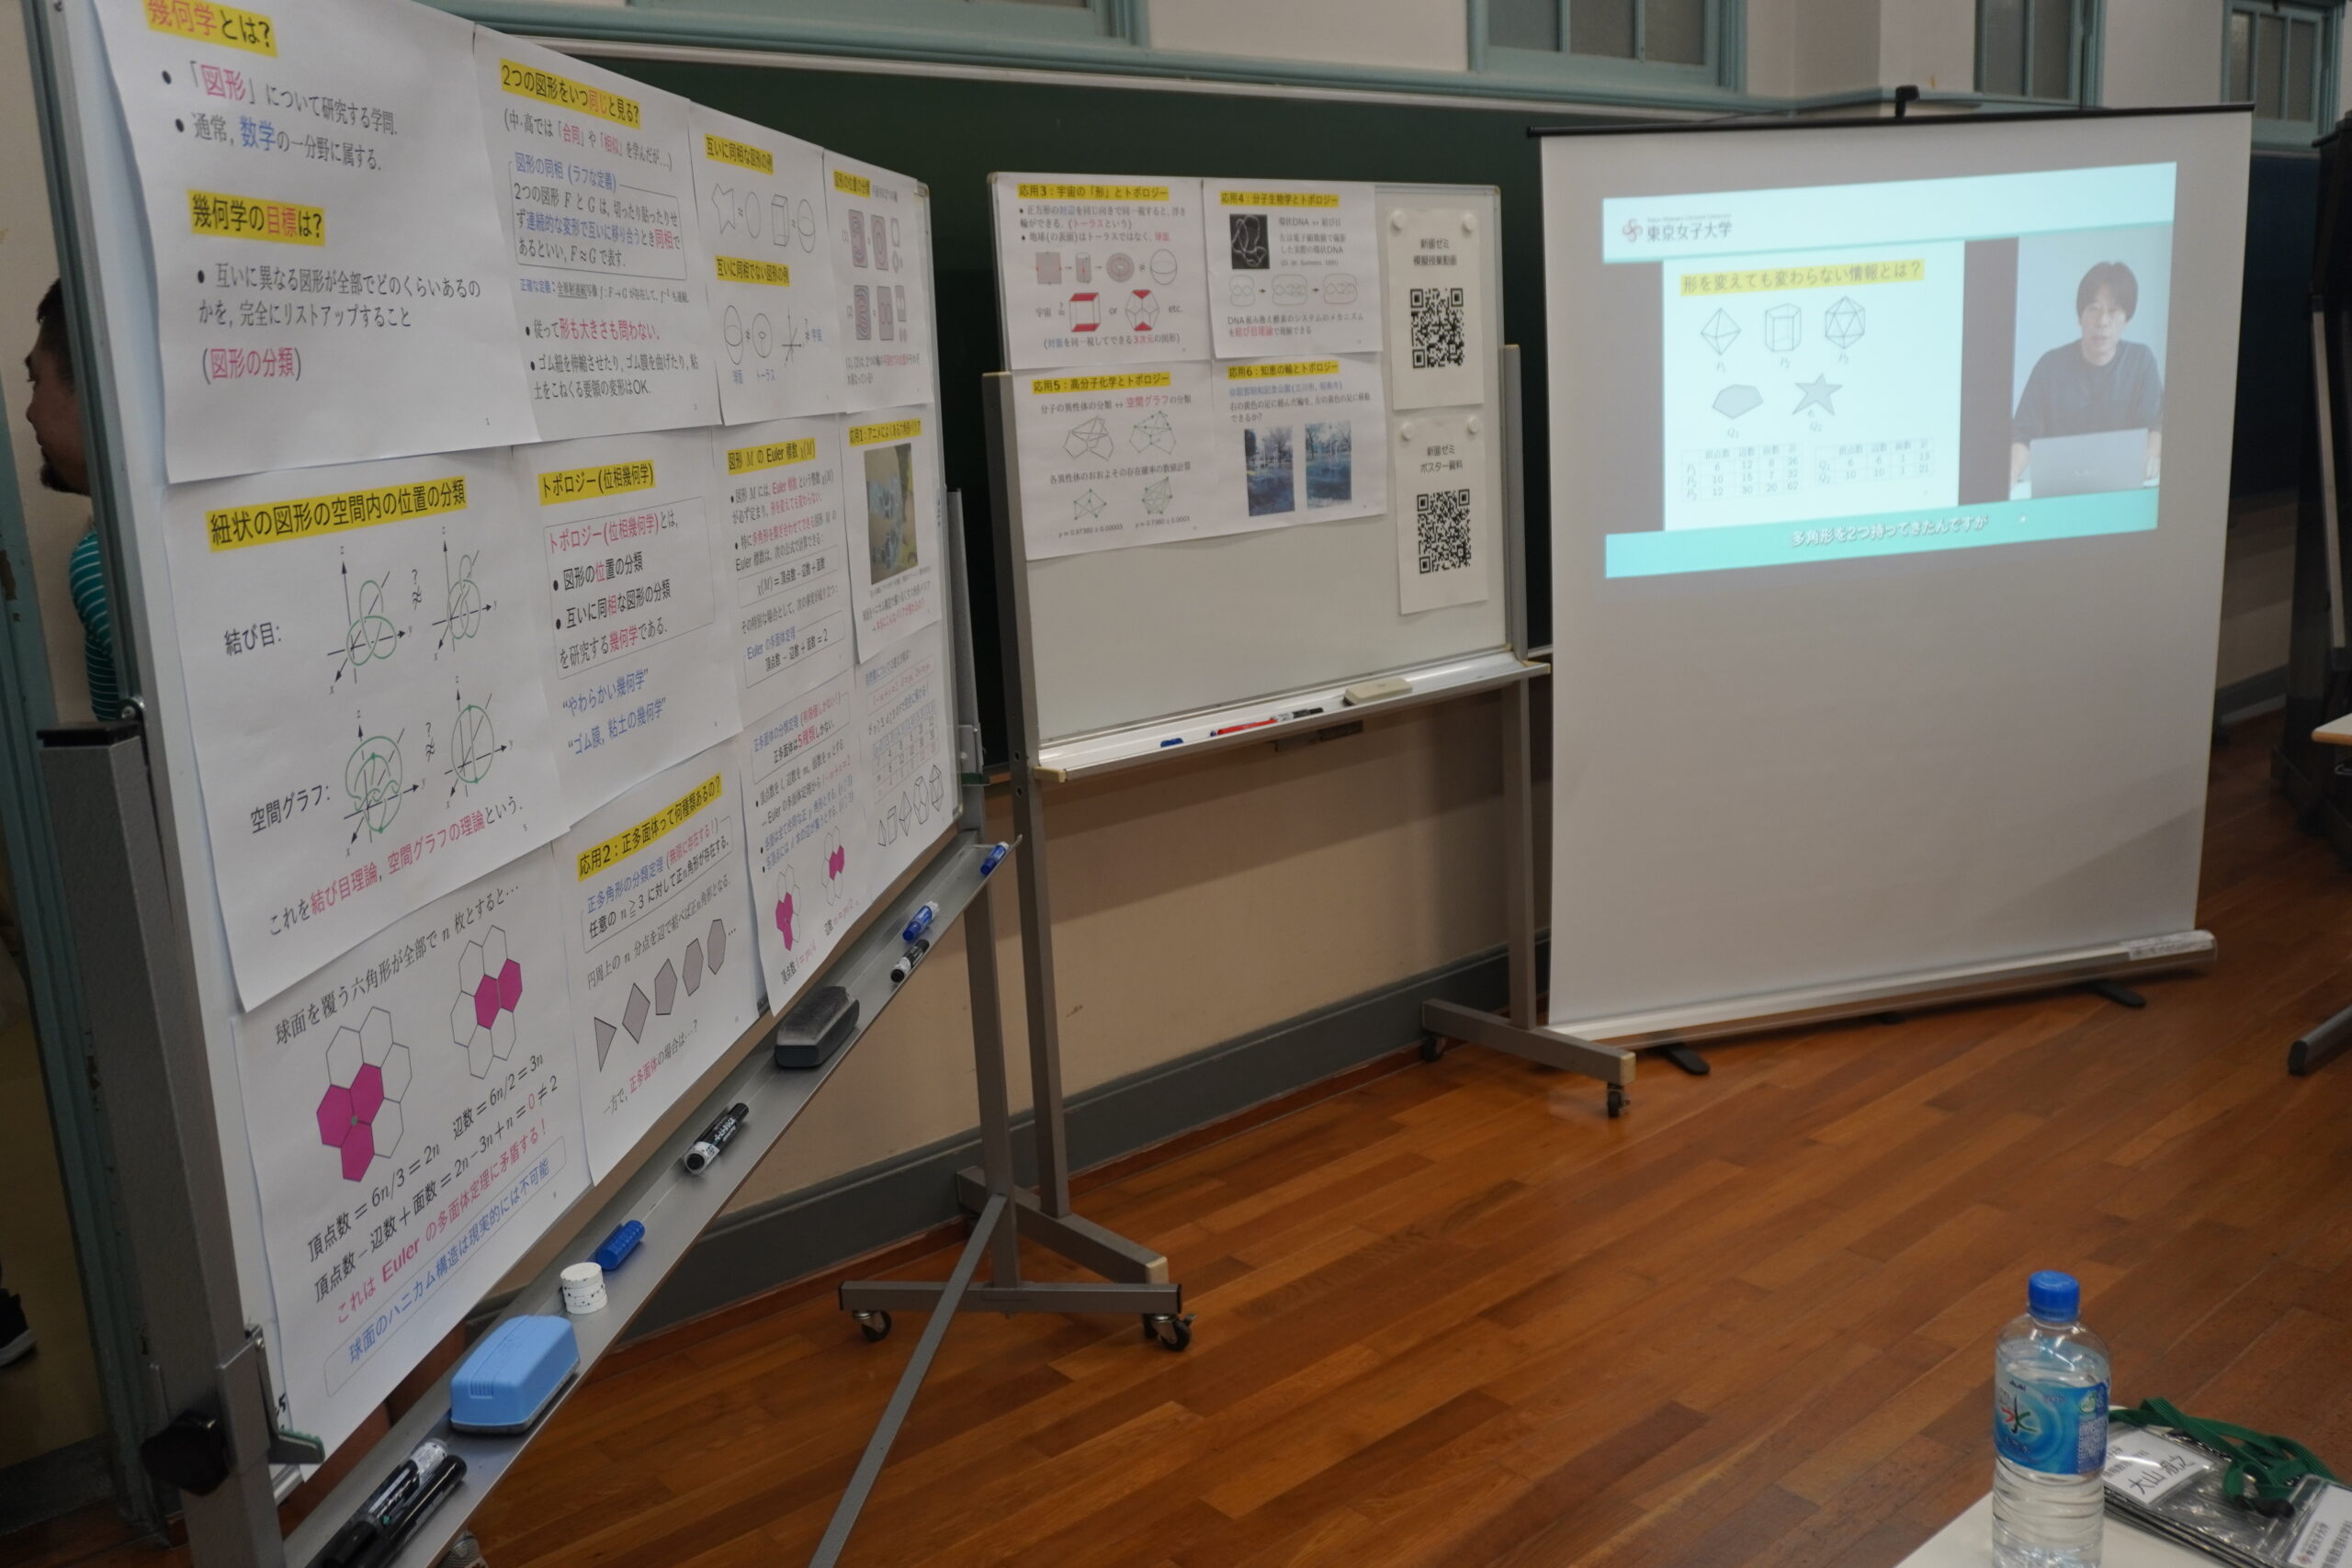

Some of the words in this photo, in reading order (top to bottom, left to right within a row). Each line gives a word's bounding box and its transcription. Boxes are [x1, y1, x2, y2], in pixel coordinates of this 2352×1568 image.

[192, 193, 322, 238] 幾何学の目標は?
[1646, 220, 1733, 243] 東京女子大学
[766, 446, 784, 463] Euler
[542, 462, 655, 499] トポロジー(位相幾何学)
[210, 479, 466, 547] 紐状の図形の空間内の位置の分類
[1792, 513, 1988, 547] 多角形を2つ持ってきたんですが
[563, 551, 643, 591] 図形の位置の分類
[735, 558, 752, 571] Euler
[566, 579, 672, 629] 互いに同相な図形の分類
[747, 644, 763, 660] Euler
[589, 909, 616, 939] 任意の
[348, 1156, 550, 1364] 球面のハニカム構造は現実的には不可能
[337, 1282, 377, 1324] これは
[381, 1238, 421, 1284] Euler
